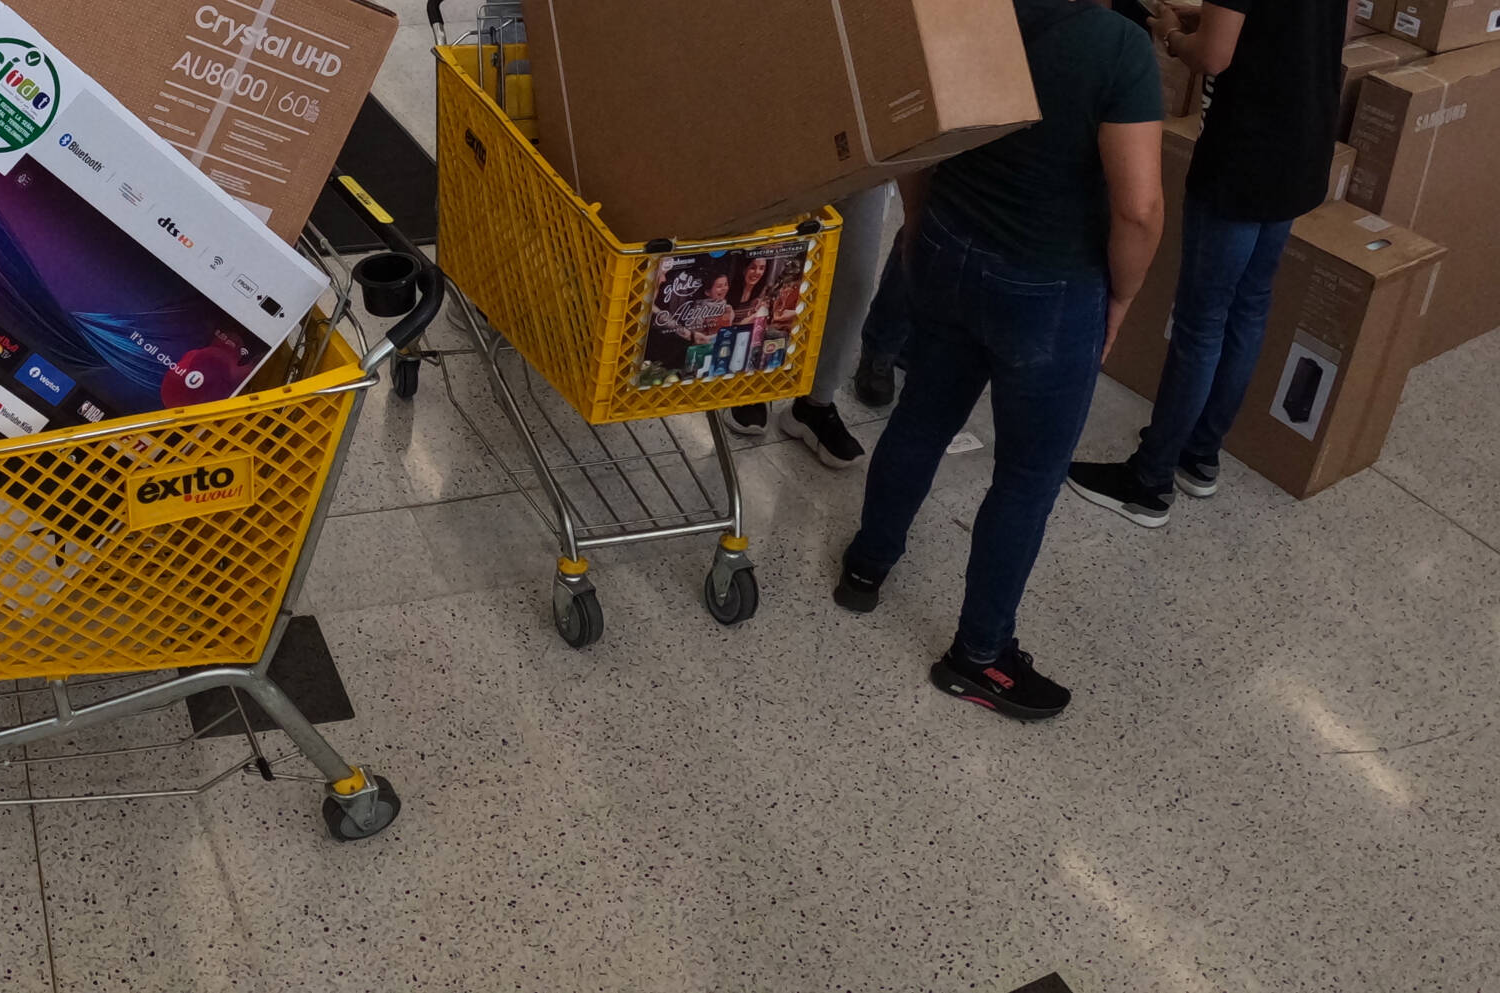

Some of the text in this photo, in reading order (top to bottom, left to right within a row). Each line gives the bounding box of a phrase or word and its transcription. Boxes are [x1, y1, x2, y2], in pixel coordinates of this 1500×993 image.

[195, 4, 343, 77] Crystal UHD
[171, 50, 268, 103] AU8000
[1414, 102, 1468, 133] SAMSUNG
[67, 139, 104, 174] Bluetooth
[157, 216, 195, 249] dts HD
[236, 278, 256, 295] FRONT
[663, 274, 703, 304] glade
[0, 335, 20, 352] Bull
[0, 349, 13, 360] TV
[129, 330, 145, 347] It's
[143, 343, 159, 357] all
[156, 353, 188, 378] about
[39, 373, 61, 394] Watch
[0, 407, 34, 434] YouTube Kids
[84, 402, 105, 423] NBA
[136, 466, 235, 505] éxito
